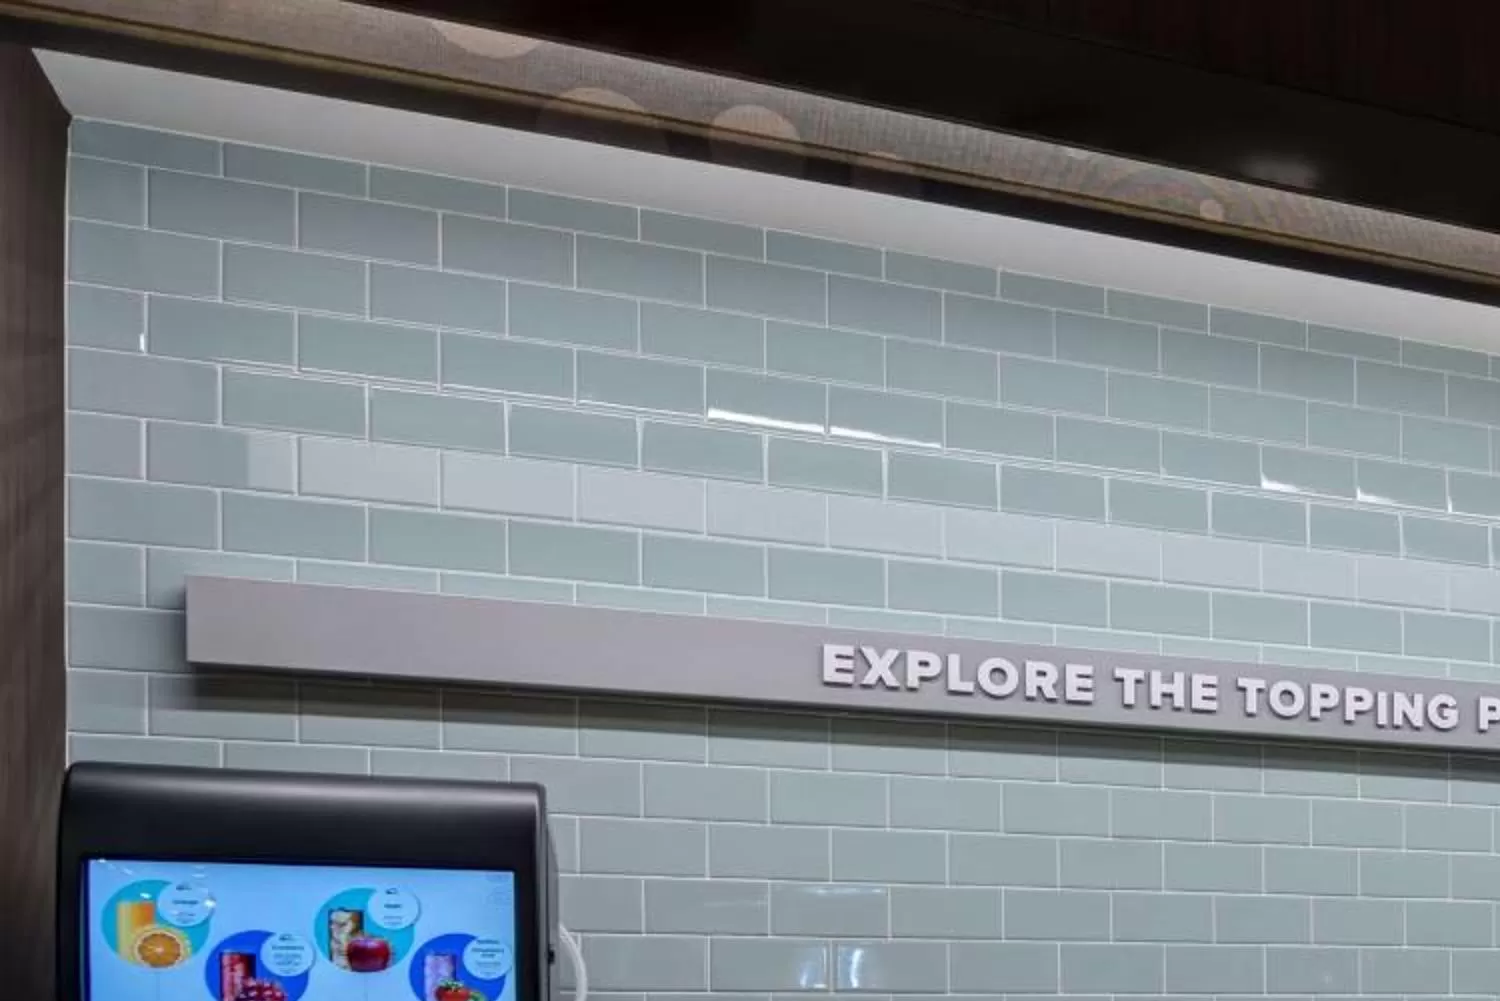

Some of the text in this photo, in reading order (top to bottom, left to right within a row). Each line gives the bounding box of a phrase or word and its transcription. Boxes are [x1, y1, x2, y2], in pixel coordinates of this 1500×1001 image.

[821, 643, 1095, 704] EXPLORE
[1113, 667, 1219, 712] THE
[1237, 676, 1460, 730] TOPPING
